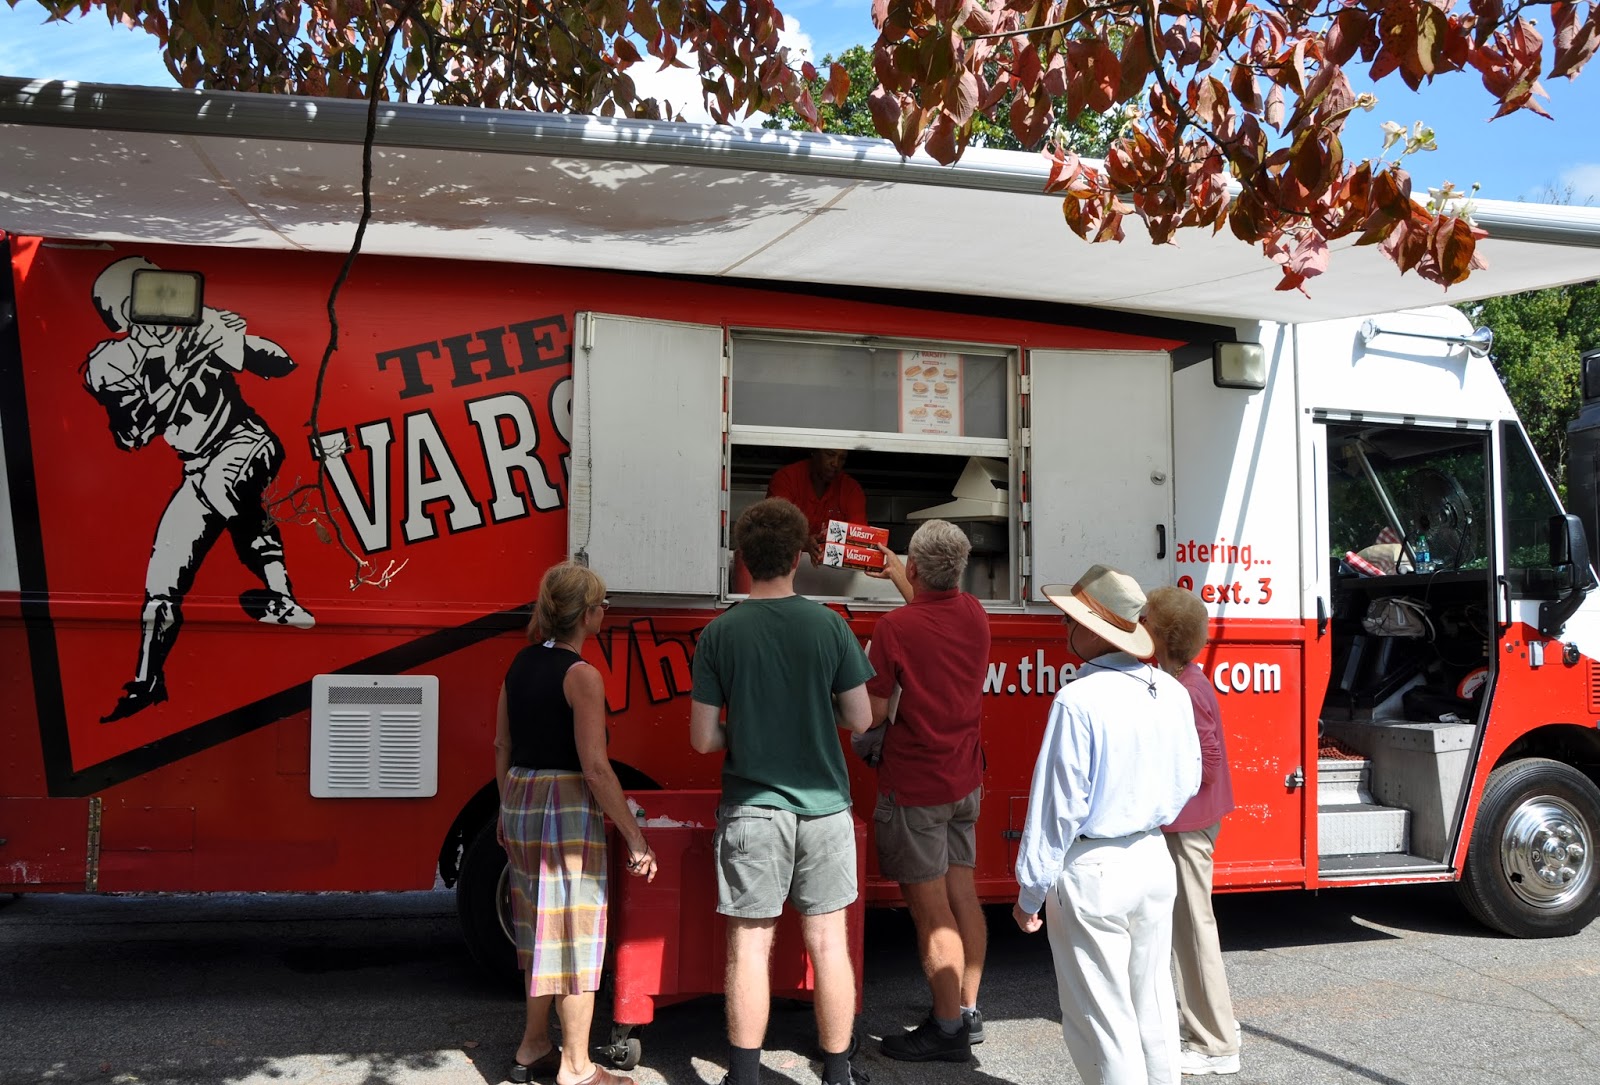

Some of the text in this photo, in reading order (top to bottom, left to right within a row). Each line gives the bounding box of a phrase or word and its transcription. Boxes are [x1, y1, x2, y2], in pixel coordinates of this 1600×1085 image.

[375, 314, 572, 400] THE
[308, 375, 572, 555] VAR
[849, 526, 875, 540] VARSITY
[846, 548, 871, 562] VARSITY
[1200, 581, 1251, 605] ext.
[1257, 577, 1273, 605] 3
